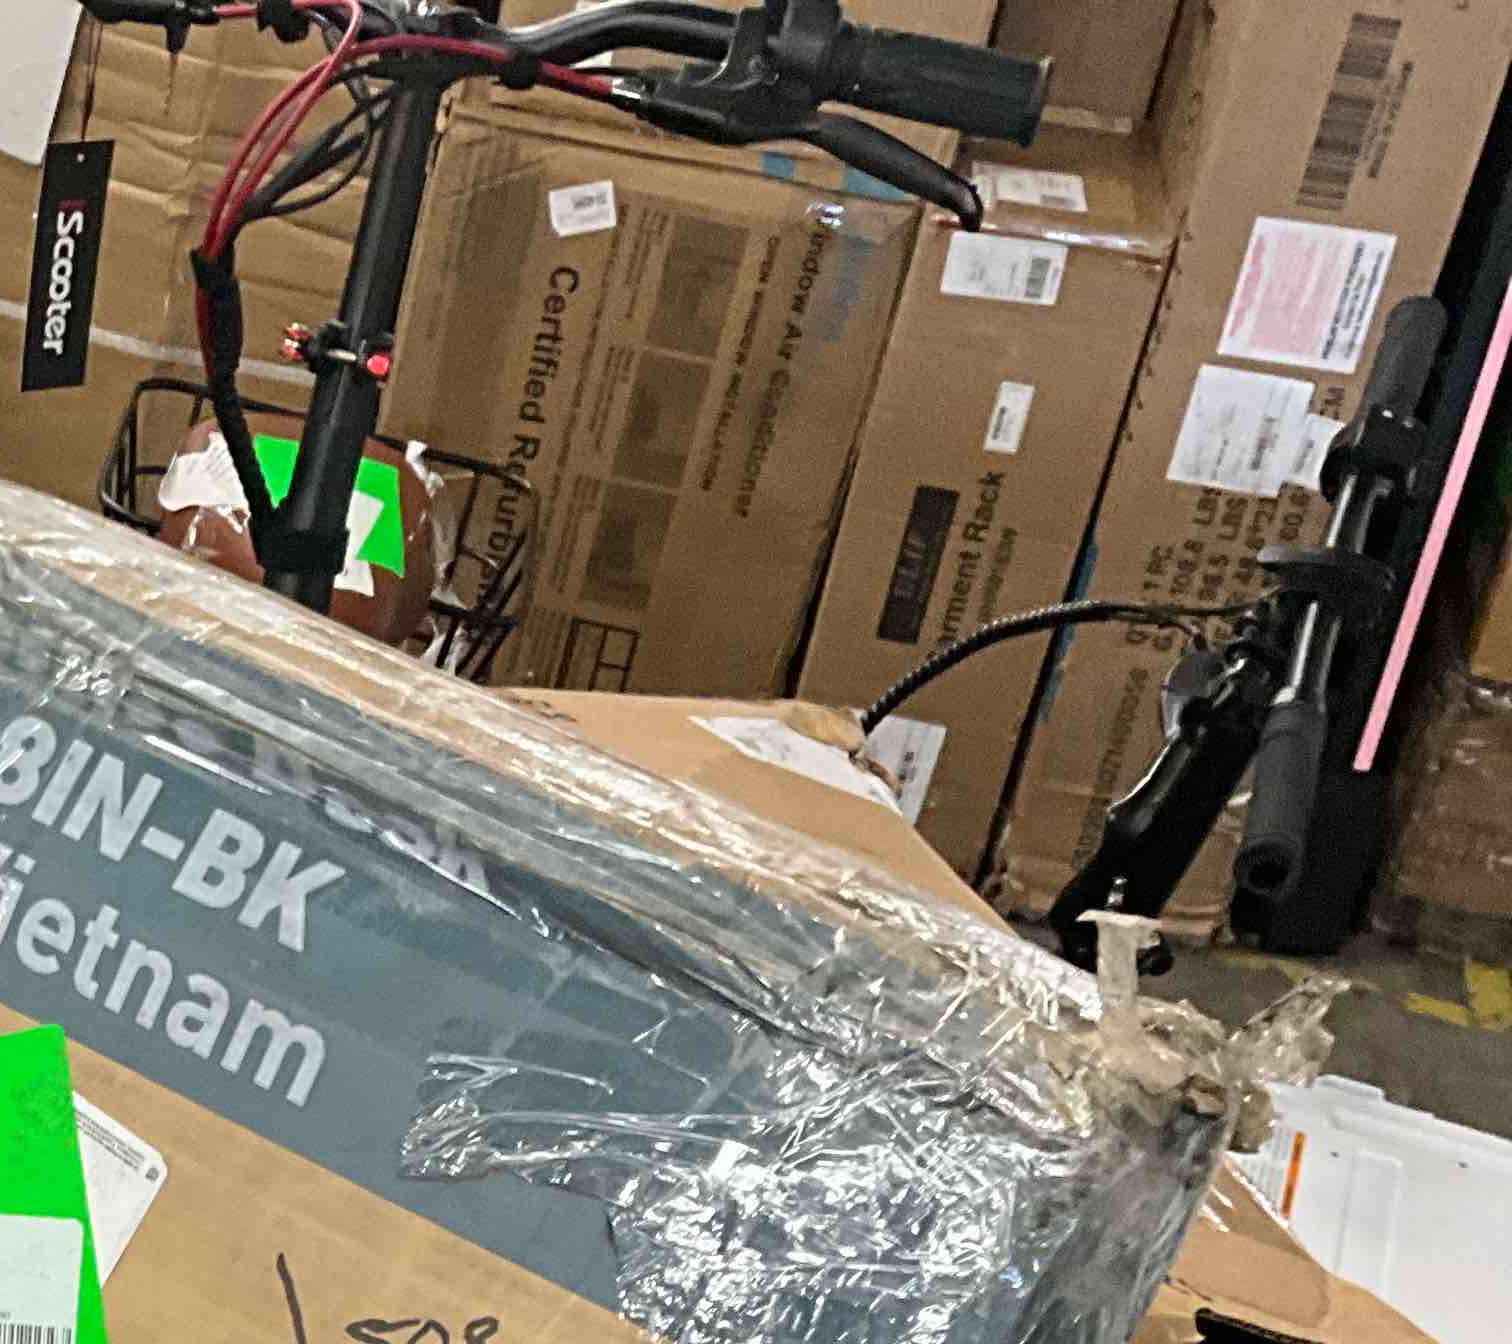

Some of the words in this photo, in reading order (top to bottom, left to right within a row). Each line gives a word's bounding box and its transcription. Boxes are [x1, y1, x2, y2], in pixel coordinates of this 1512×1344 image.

[42, 210, 85, 356] Scooter
[520, 266, 580, 424] Certified
[964, 469, 1006, 545] Rack
